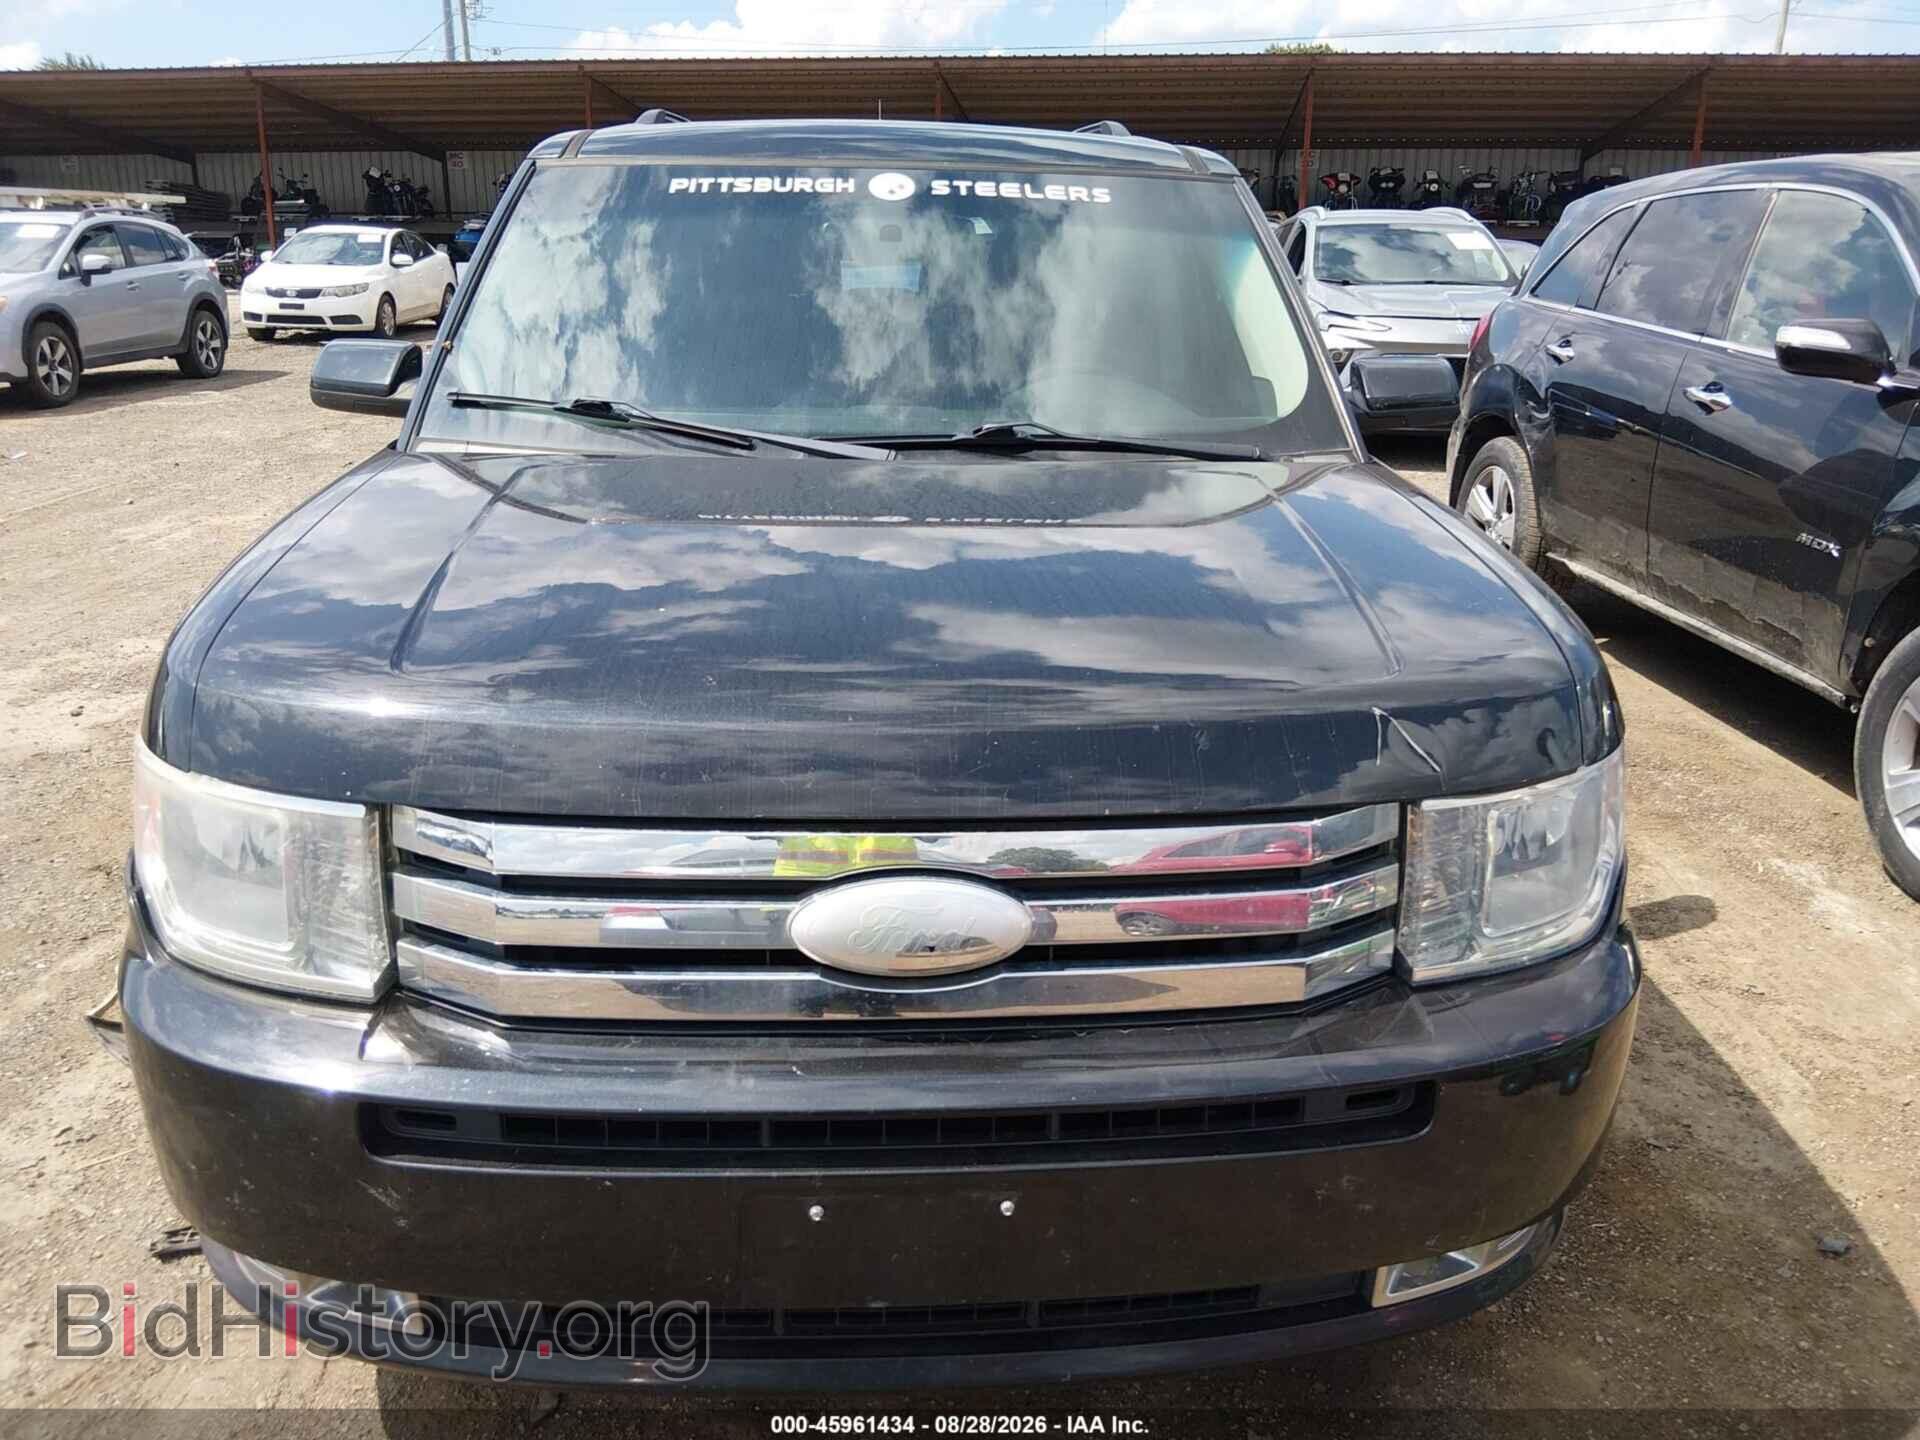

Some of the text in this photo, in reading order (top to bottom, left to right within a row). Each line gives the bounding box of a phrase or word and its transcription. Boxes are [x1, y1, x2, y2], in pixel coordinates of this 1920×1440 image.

[668, 177, 1111, 203] PITTSBURGH STEELERS
[848, 903, 977, 953] Ford
